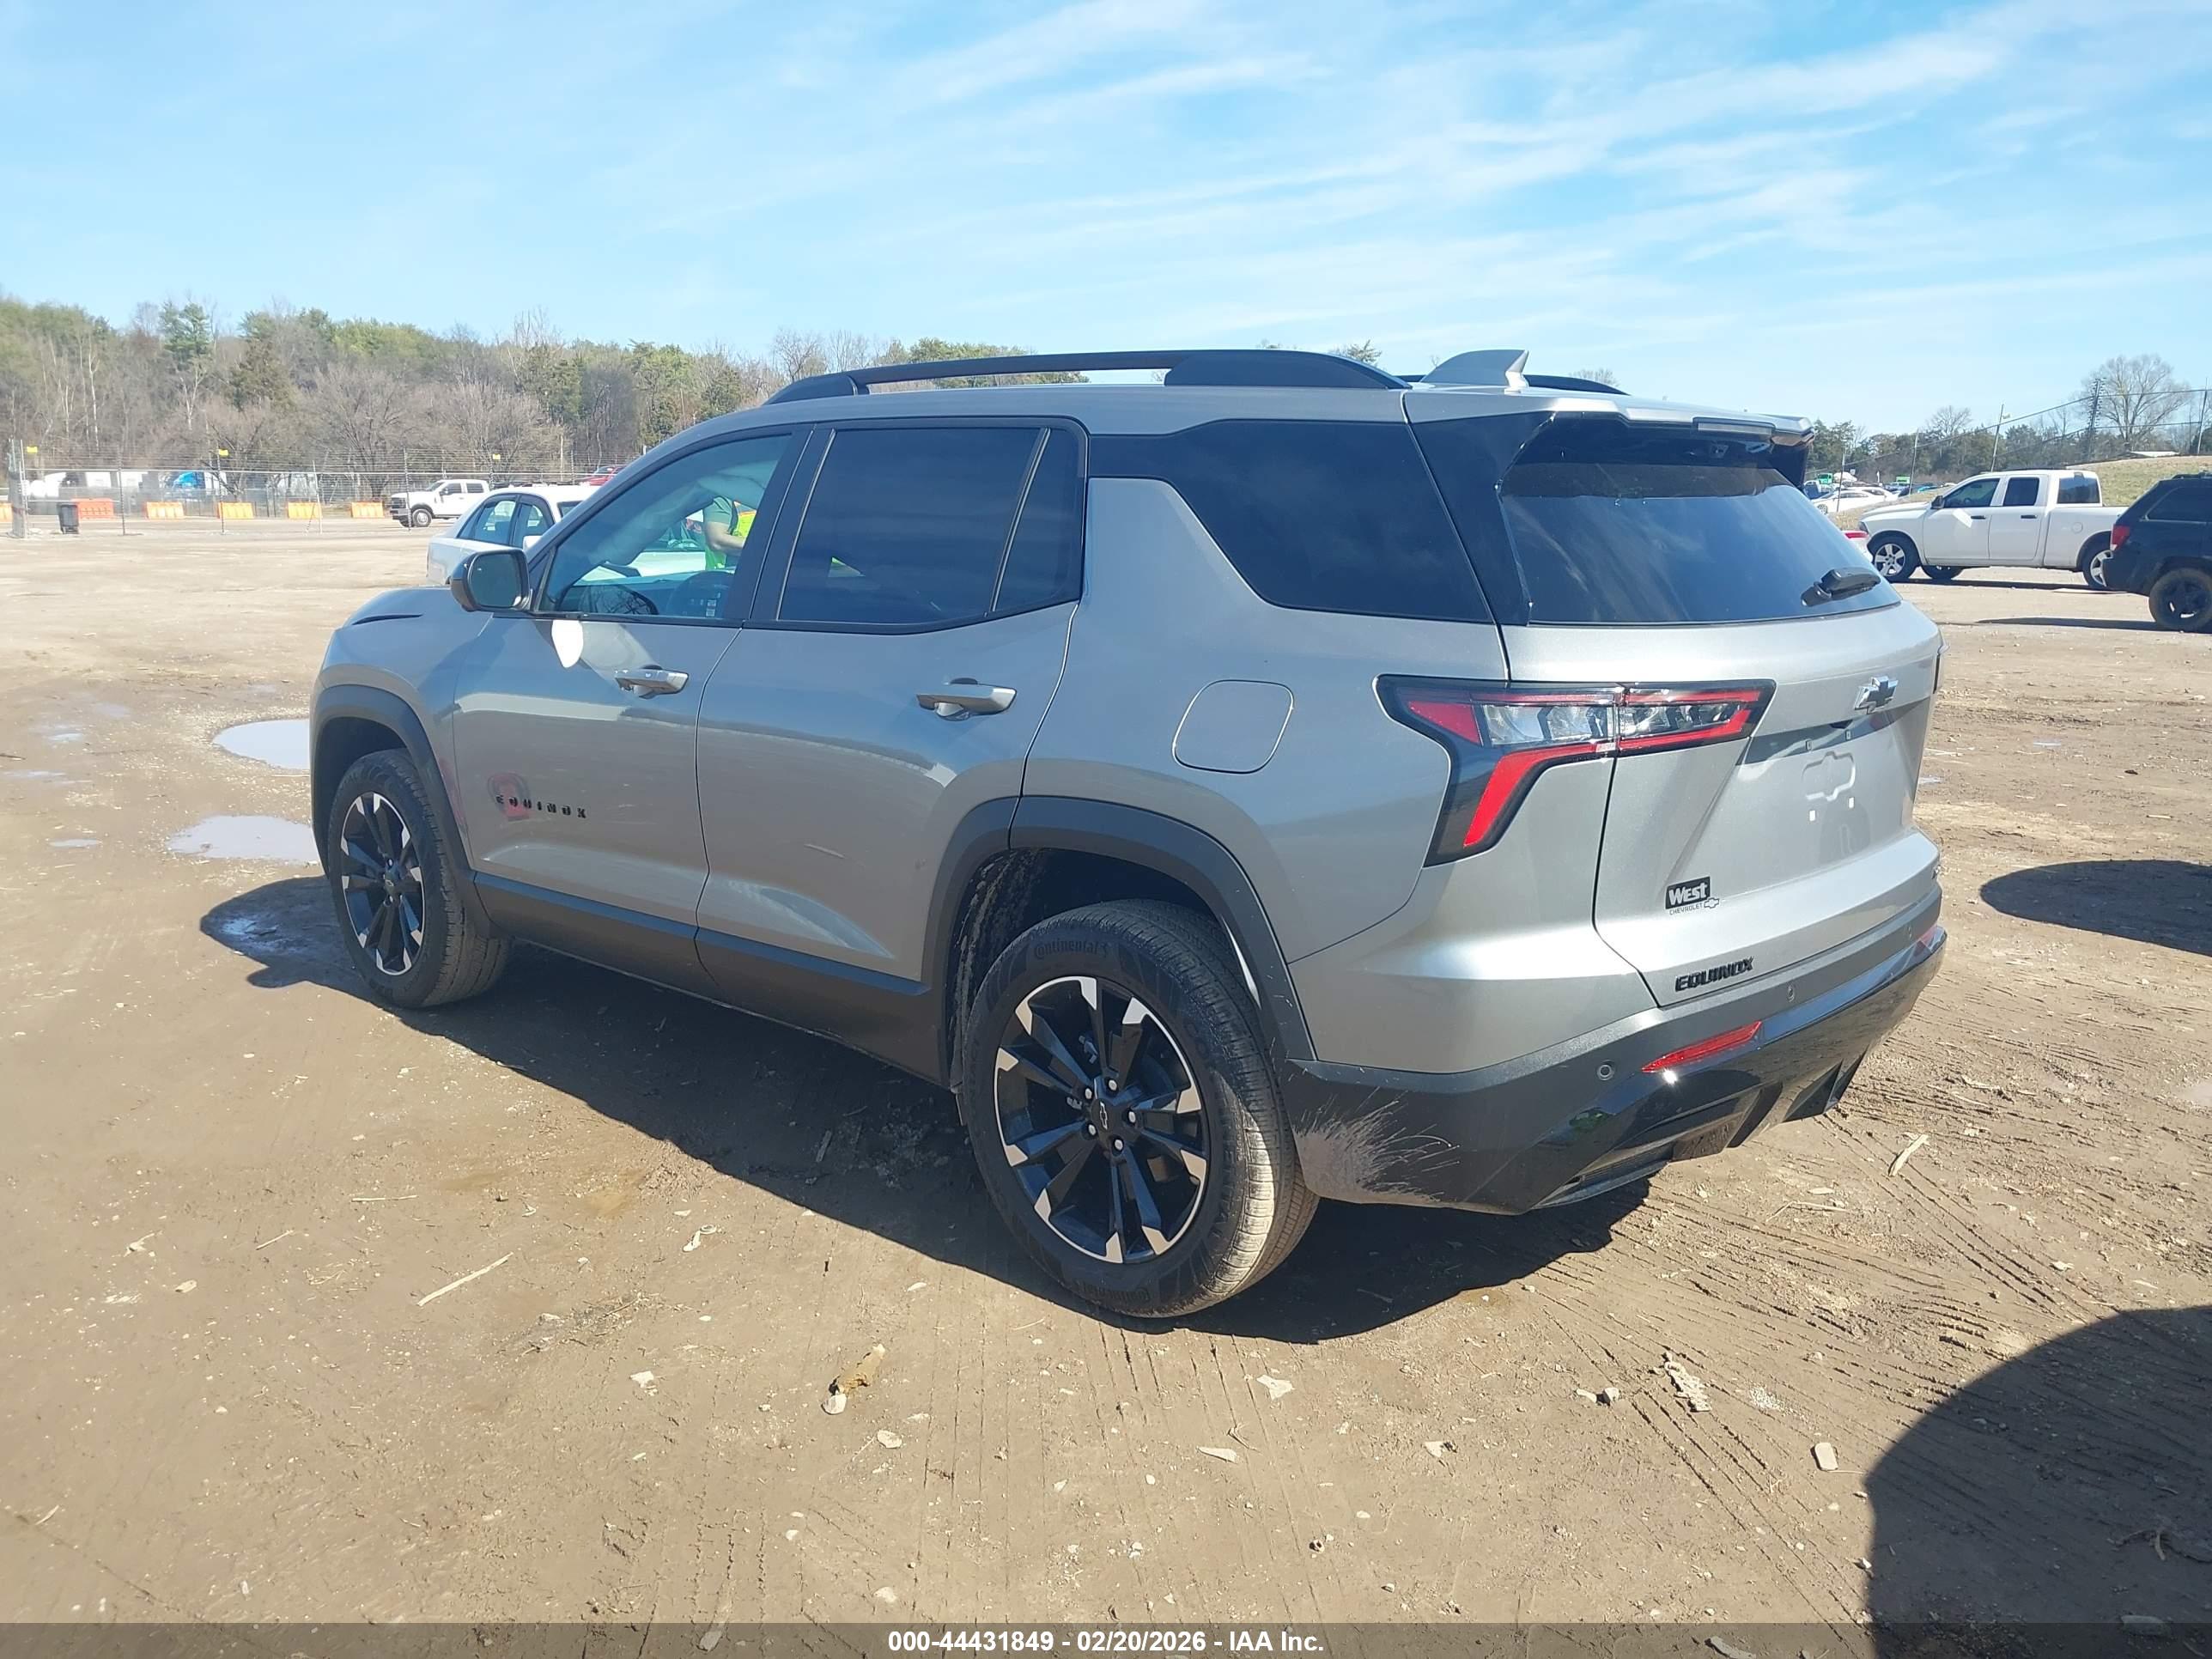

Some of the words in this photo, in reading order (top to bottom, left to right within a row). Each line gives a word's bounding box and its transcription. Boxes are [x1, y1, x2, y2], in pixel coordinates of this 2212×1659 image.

[495, 794, 586, 818] EQUINOX
[1669, 902, 1704, 915] CHEVROLET
[1674, 957, 1754, 992] EQUINOX
